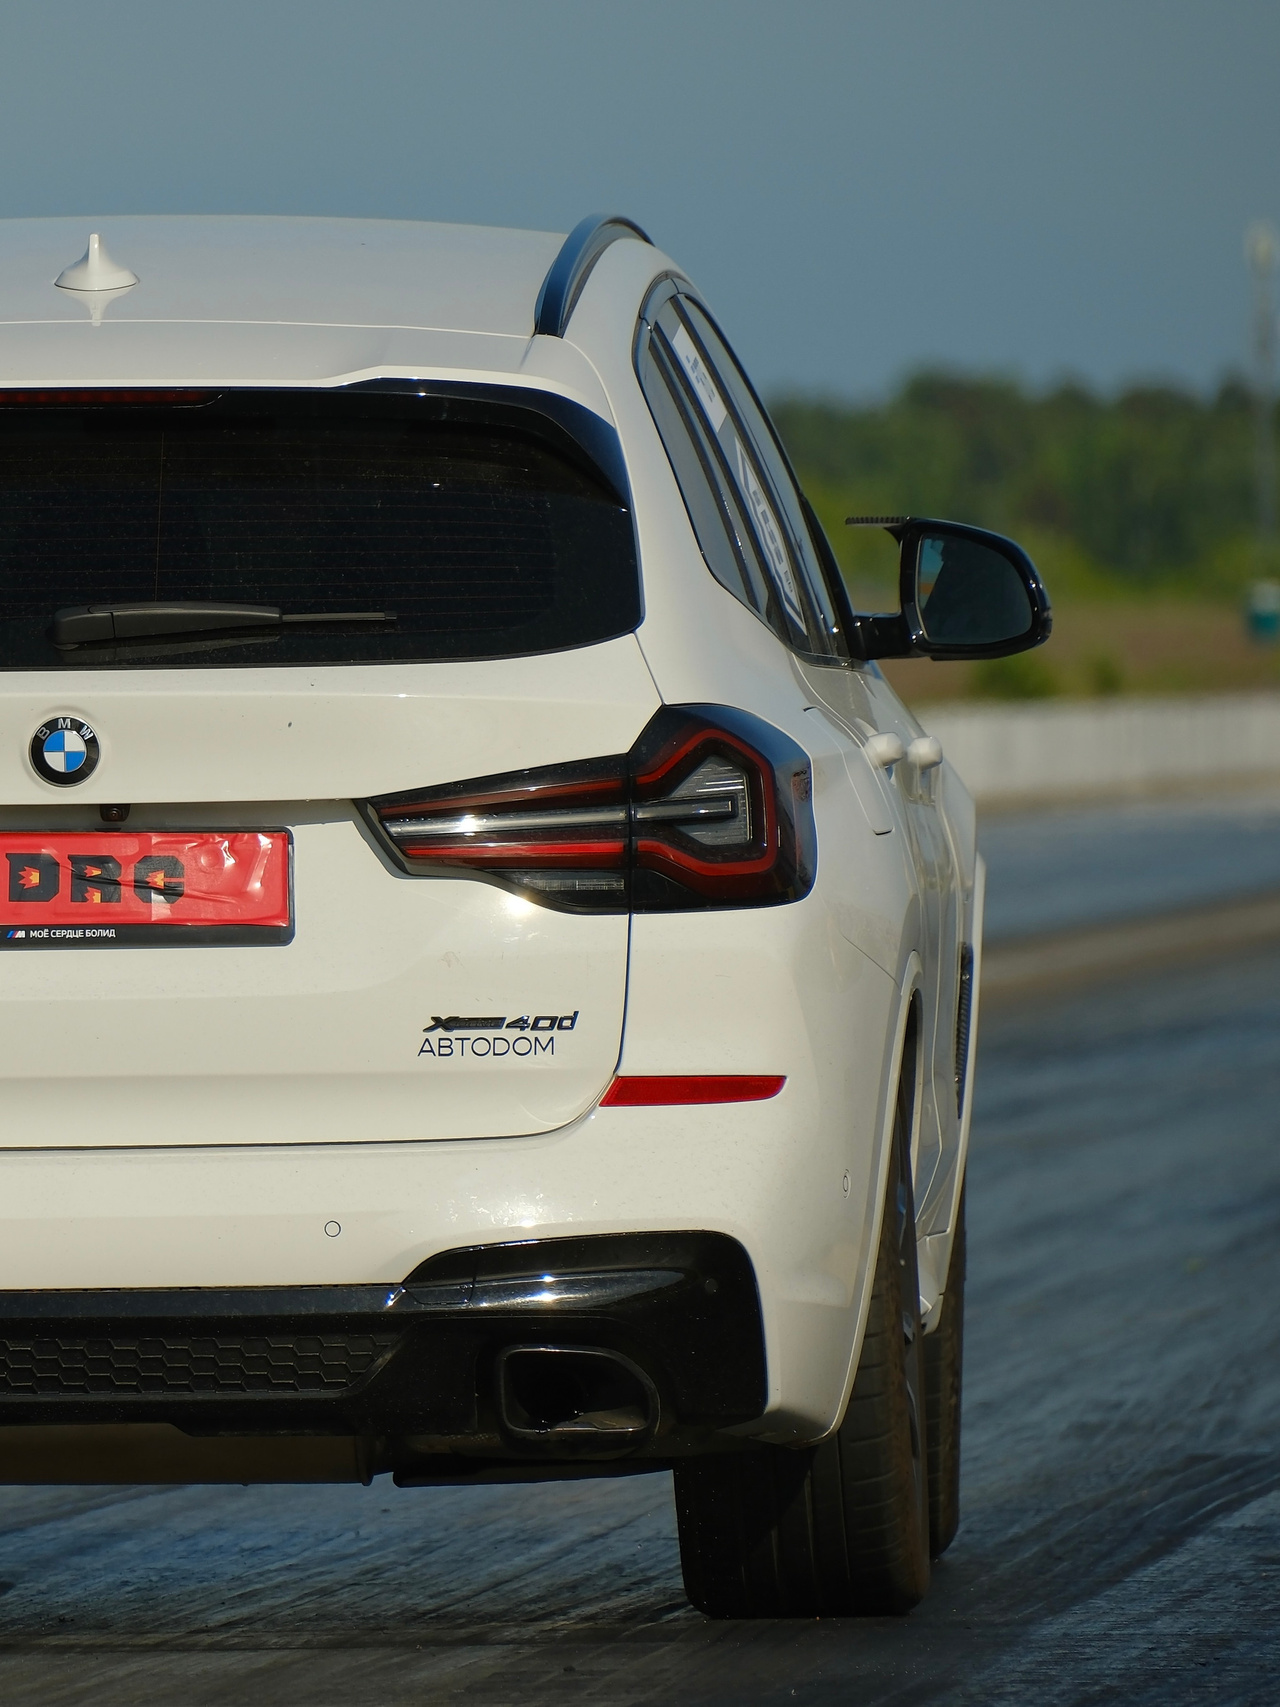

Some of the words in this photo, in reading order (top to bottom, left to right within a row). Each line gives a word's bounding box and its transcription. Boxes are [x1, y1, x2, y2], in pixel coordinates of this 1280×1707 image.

[36, 718, 94, 740] BMW
[29, 929, 50, 938] МОЁ
[50, 930, 84, 939] СЕРДЦЕ
[85, 929, 116, 938] БОЛИД
